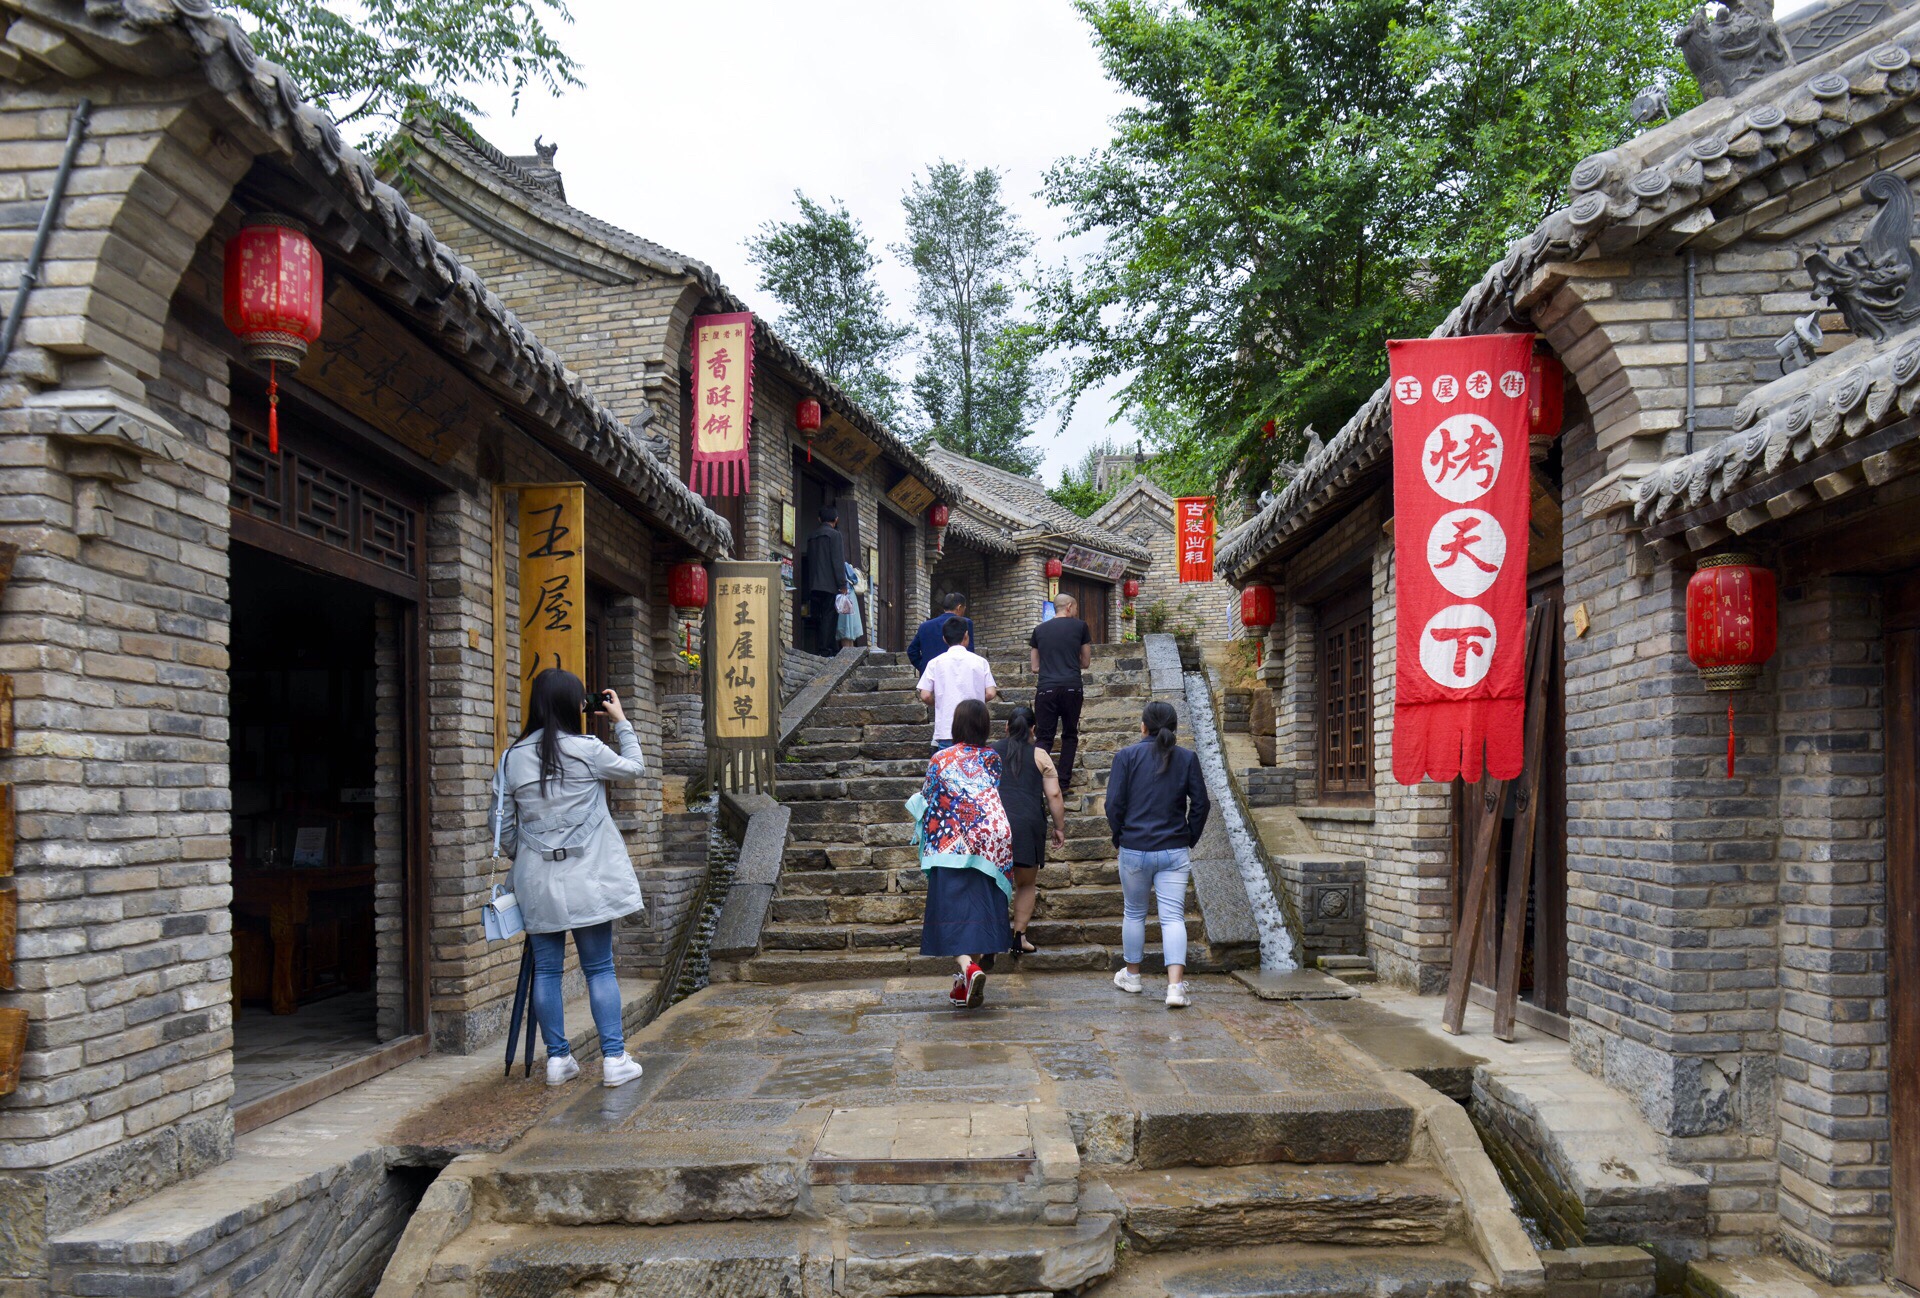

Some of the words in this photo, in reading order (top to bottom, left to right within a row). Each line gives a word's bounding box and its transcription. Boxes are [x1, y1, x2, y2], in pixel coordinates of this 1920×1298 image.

[701, 329, 743, 342] 王屋老街
[703, 348, 735, 440] 香酥饼
[1399, 369, 1526, 401] 王屋老街
[1430, 424, 1499, 678] 烤天下
[718, 584, 767, 596] 王屋老街
[724, 600, 759, 729] 王屋仙草
